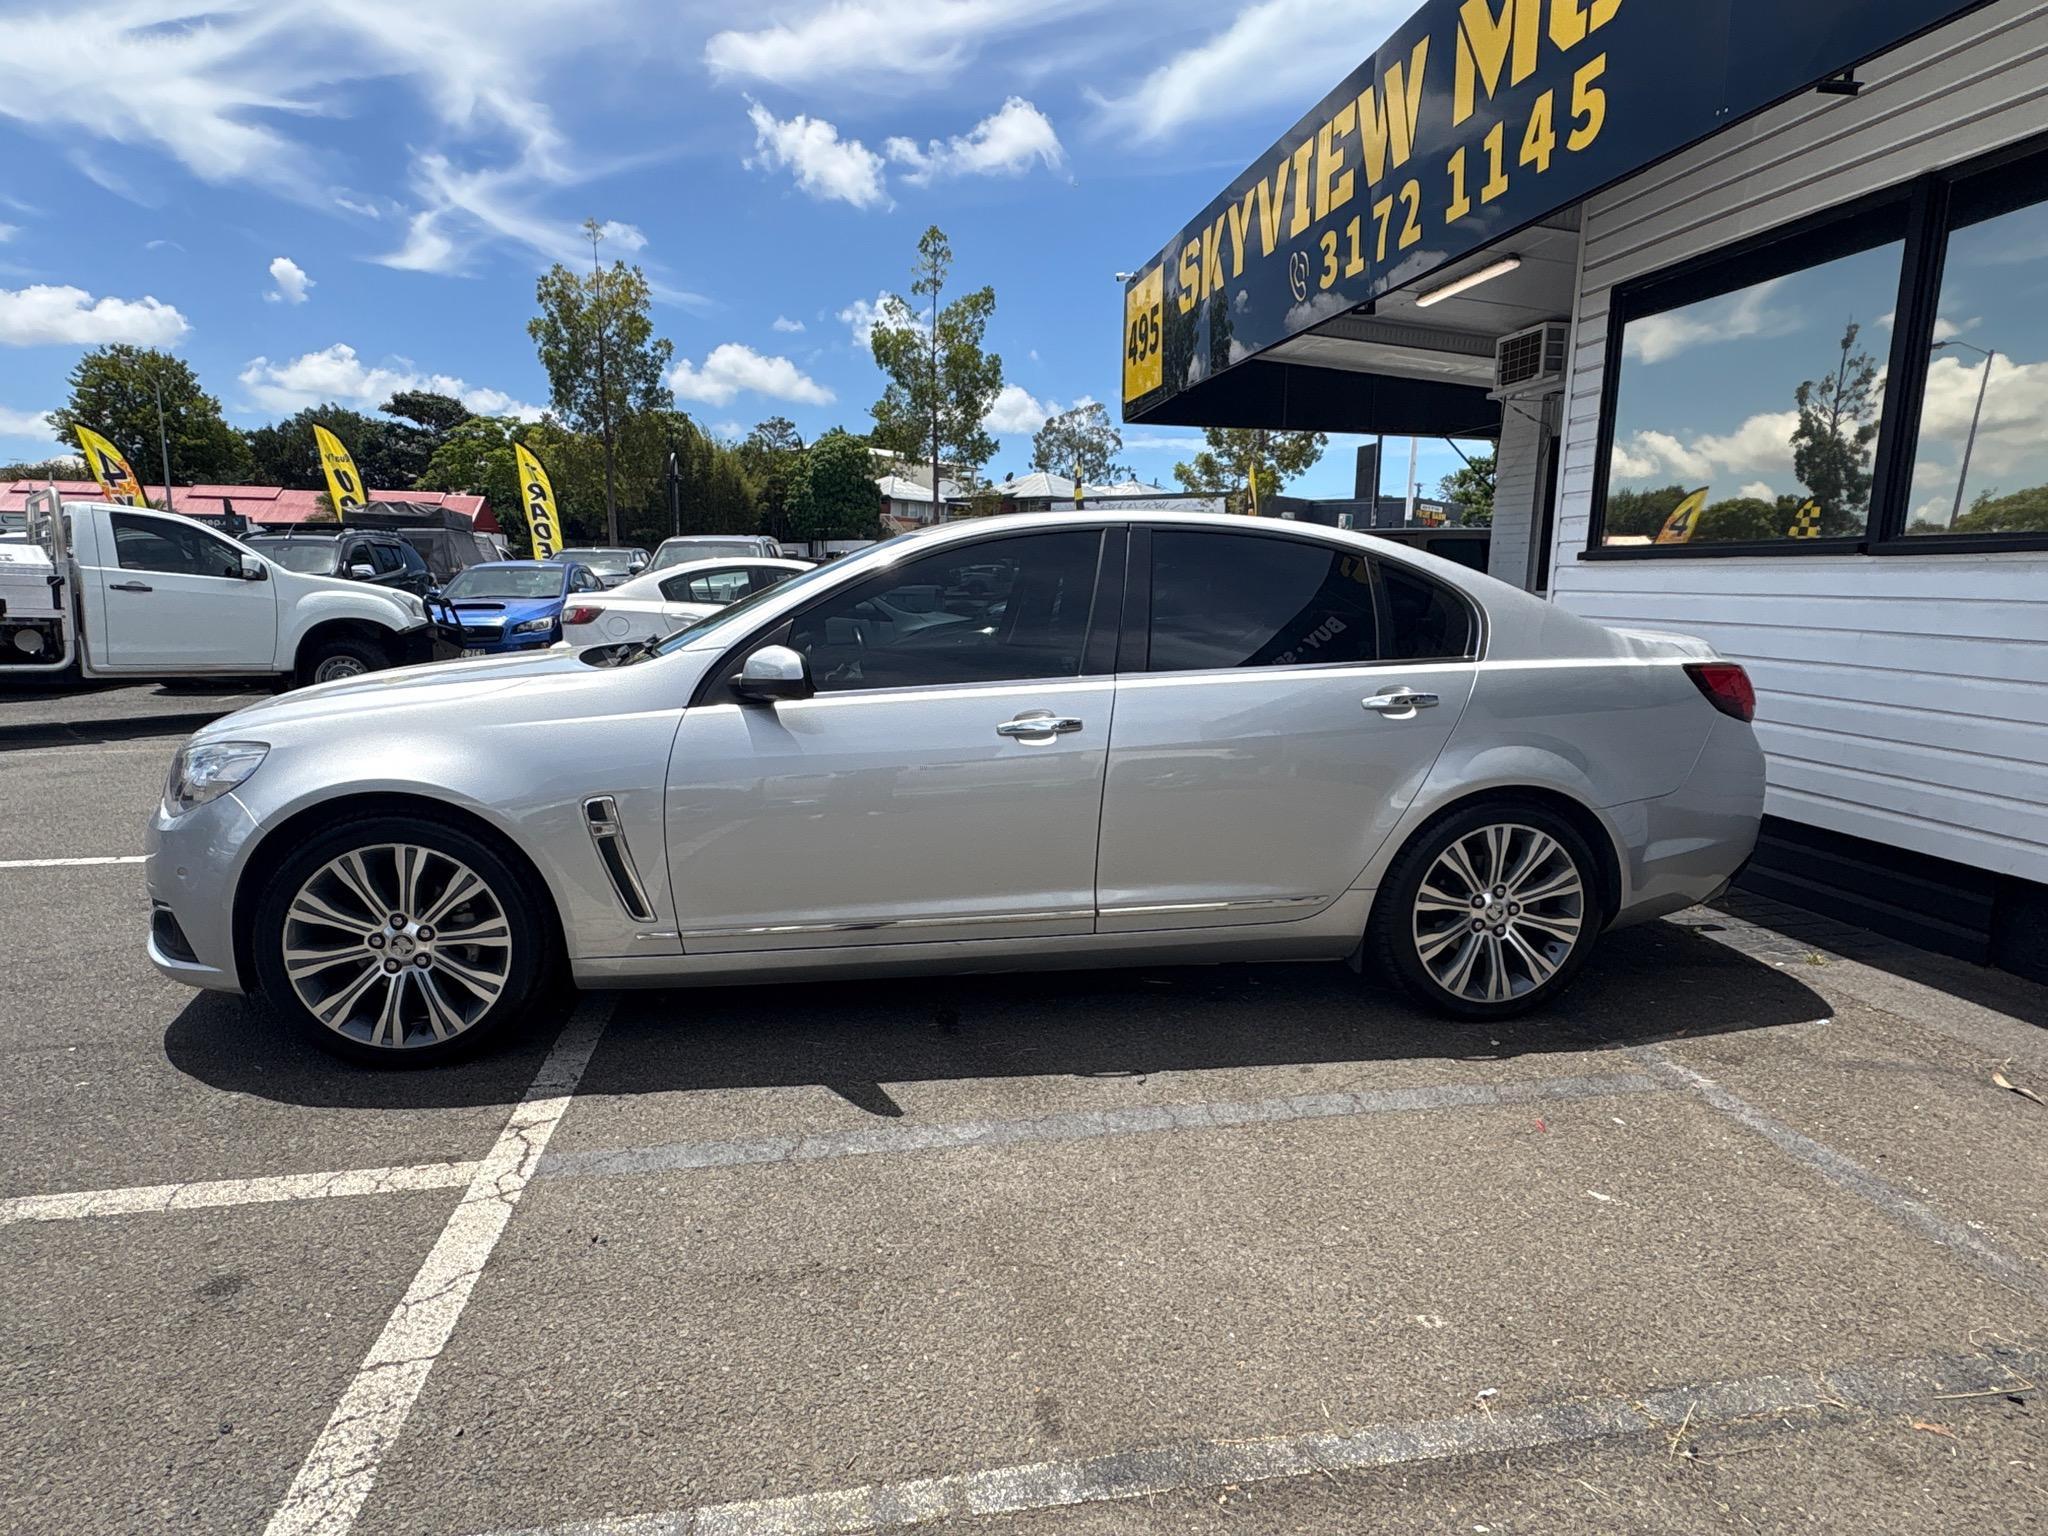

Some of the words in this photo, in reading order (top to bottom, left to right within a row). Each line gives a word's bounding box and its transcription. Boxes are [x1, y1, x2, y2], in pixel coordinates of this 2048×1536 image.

[1178, 35, 1431, 314] SKYVIEW
[1319, 178, 1422, 289] 3172
[1445, 52, 1607, 224] 1145
[1128, 303, 1161, 367] 495
